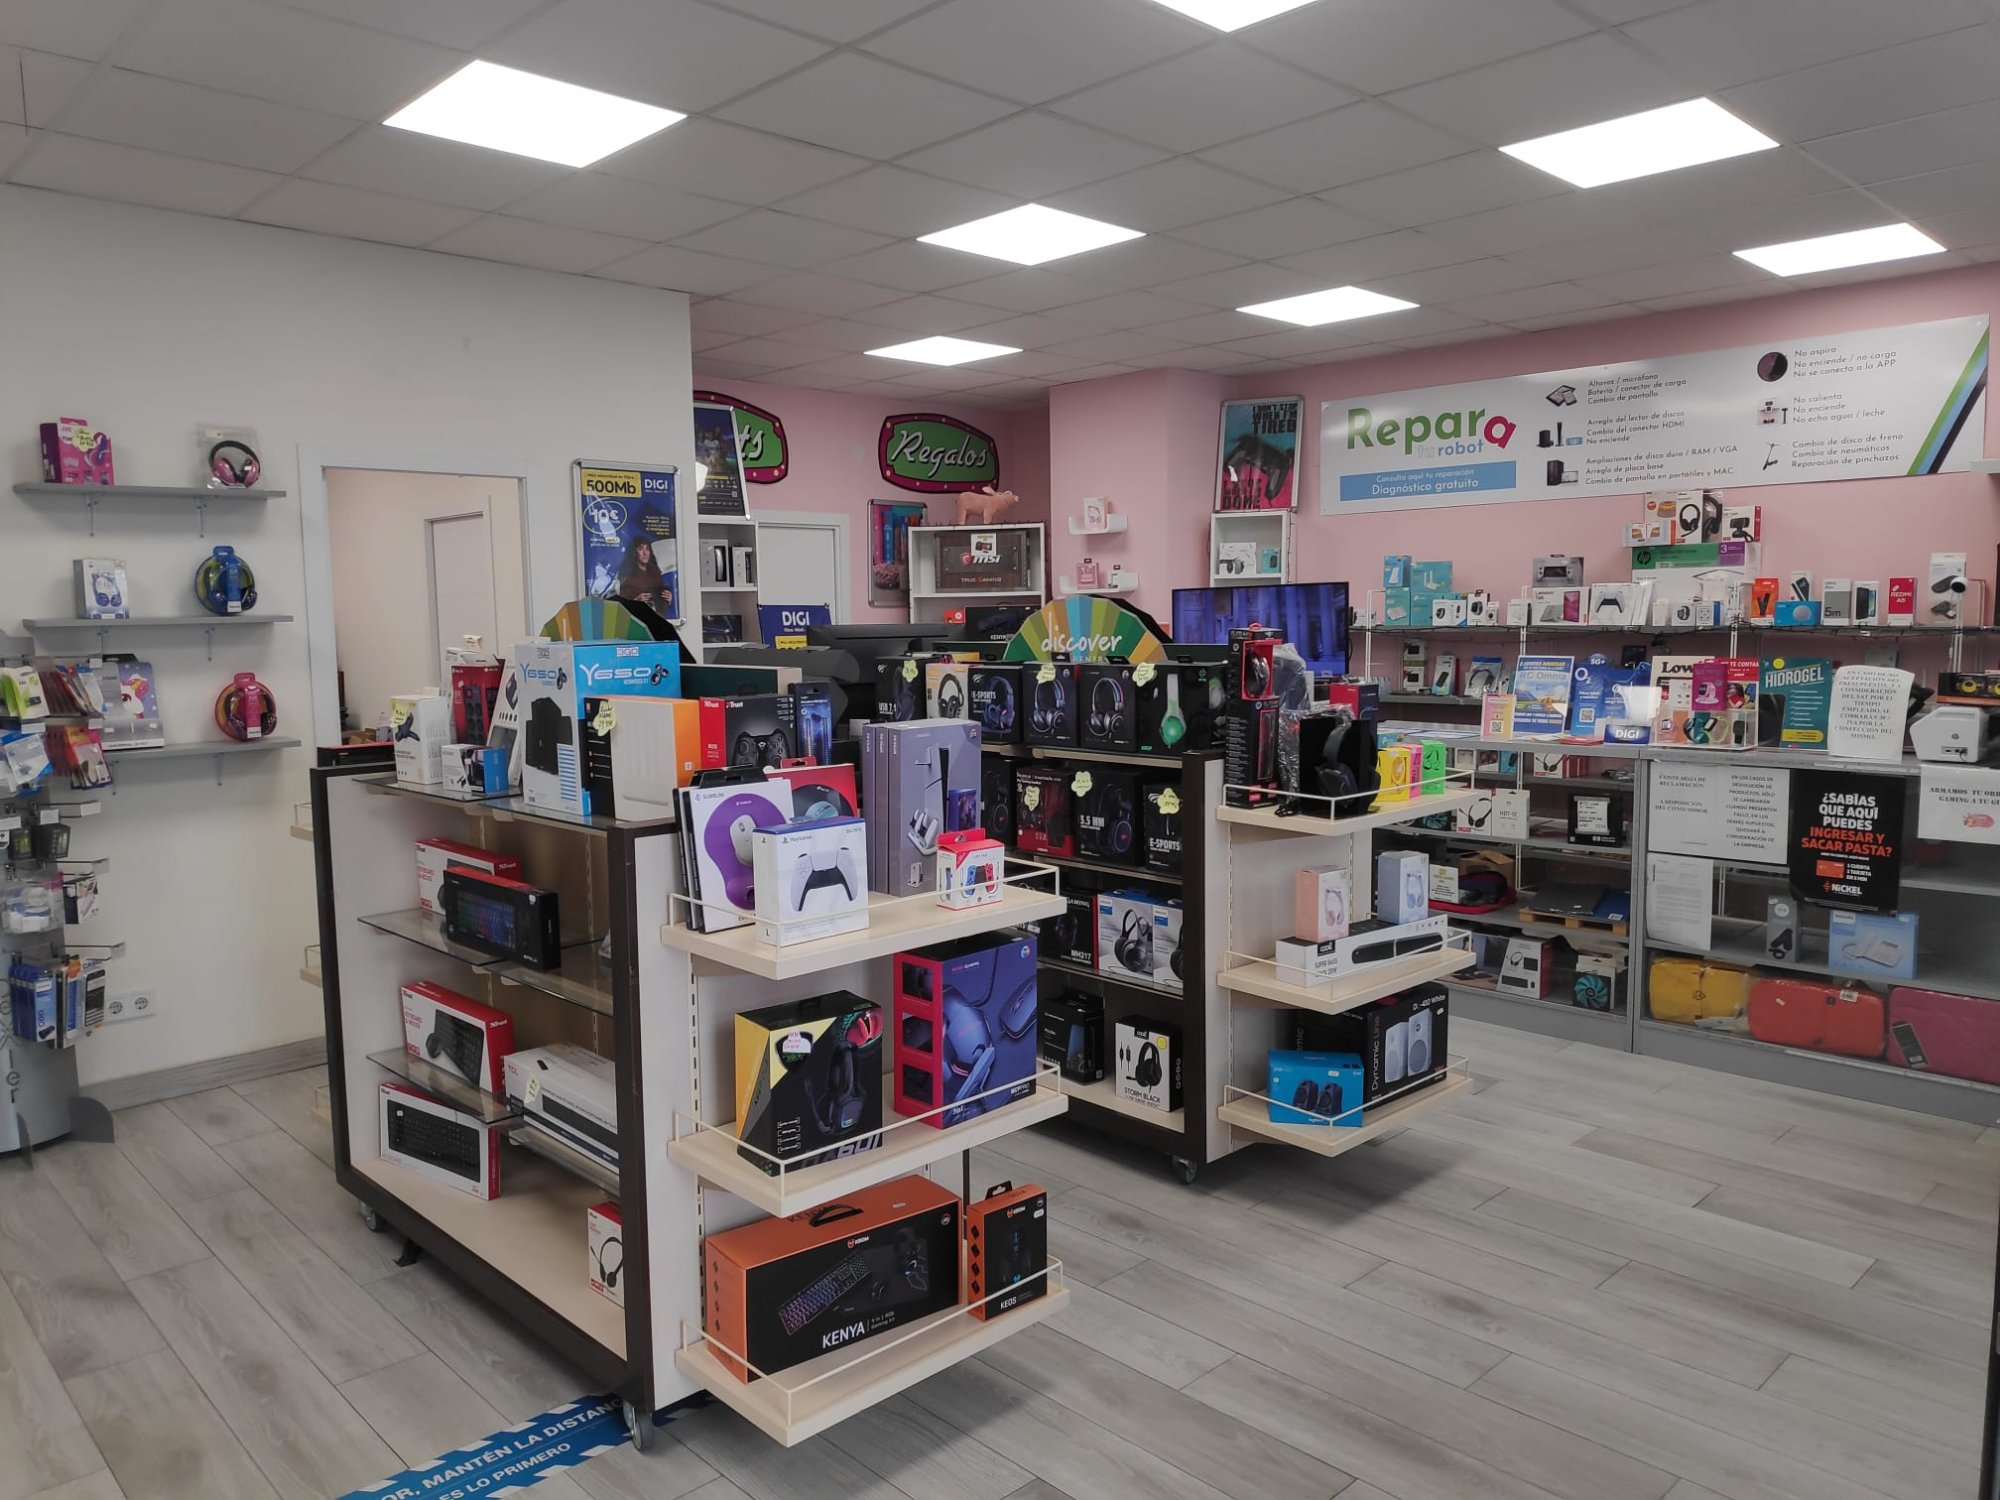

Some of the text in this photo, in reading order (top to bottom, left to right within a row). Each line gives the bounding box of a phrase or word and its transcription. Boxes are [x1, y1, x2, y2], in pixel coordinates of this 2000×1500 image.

[1794, 349, 1807, 357] No
[1794, 360, 1807, 368] No
[1793, 370, 1806, 378] No
[1793, 396, 1806, 404] No
[1793, 406, 1806, 414] No
[1253, 420, 1297, 435] TIRED
[1662, 421, 1685, 429] HDMI
[1793, 416, 1806, 424] No
[1347, 407, 1517, 455] Repara
[890, 430, 988, 477] Regalos
[1437, 440, 1485, 457] robot
[1691, 448, 1711, 456] RAM
[1719, 445, 1738, 454] VGA
[1713, 466, 1734, 475] MAC
[586, 479, 637, 496] 500Mb
[644, 479, 668, 491] DIGI
[1372, 479, 1479, 496] Diagnóstico gratuito
[781, 610, 811, 627] DIGI
[1040, 611, 1122, 654] discover
[579, 662, 652, 686] Y650
[1765, 667, 1825, 689] HIDROGEL
[729, 700, 744, 709] Trust
[1615, 729, 1641, 740] DIGI
[1818, 803, 1879, 820] QUE AQUÍ
[1822, 815, 1873, 831] PUEDES
[1809, 826, 1886, 844] INGRESAR Y
[1149, 837, 1181, 851] E-SPORTS
[1801, 836, 1844, 852] SACAR
[1845, 842, 1893, 857] PASTA?
[1371, 1040, 1381, 1092] Dynamic
[1124, 1086, 1143, 1099] STORM
[1142, 1092, 1161, 1104] BLACK
[1000, 1296, 1018, 1310] KEOS
[821, 1320, 866, 1349] KENYA
[423, 1444, 514, 1490] MANTÉN
[514, 1434, 544, 1452] LA
[465, 1442, 572, 1493] LO PRIMERO
